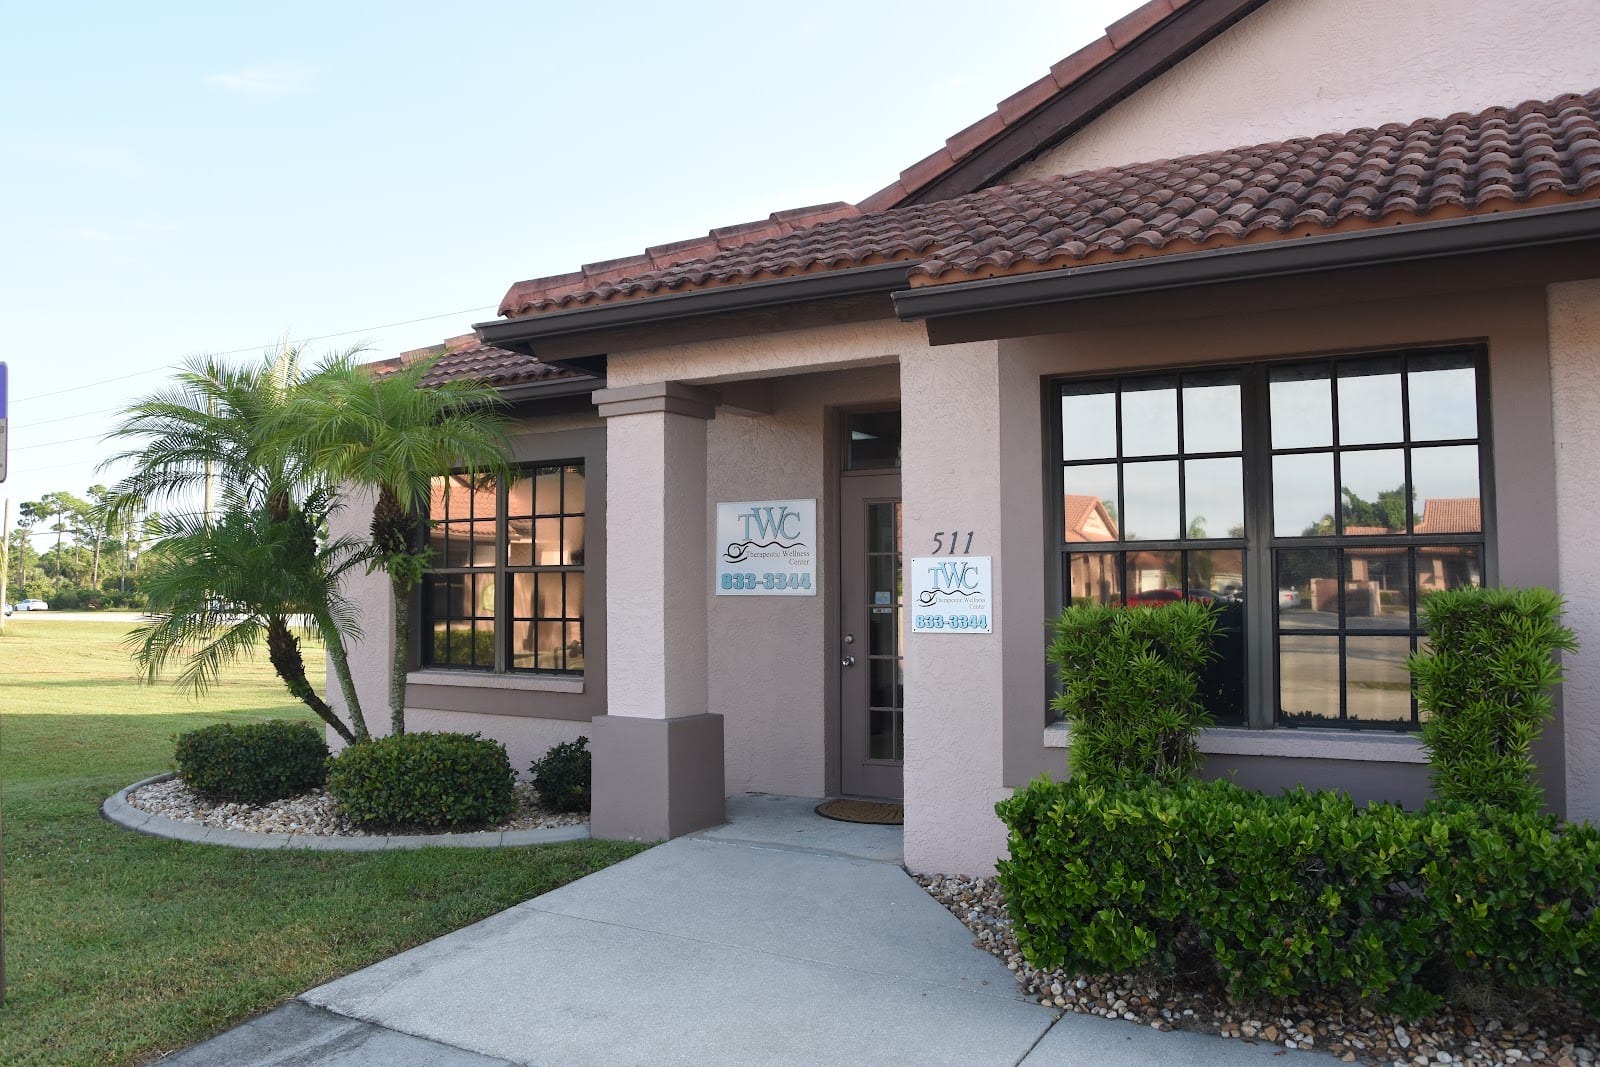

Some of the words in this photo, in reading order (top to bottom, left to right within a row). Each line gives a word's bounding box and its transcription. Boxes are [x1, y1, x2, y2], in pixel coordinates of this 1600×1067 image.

[738, 506, 801, 541] TWC
[782, 549, 810, 558] Wellness
[932, 531, 974, 555] 511
[721, 572, 812, 590] 833-3344
[928, 562, 978, 589] TWC
[916, 615, 988, 629] 833-3344
